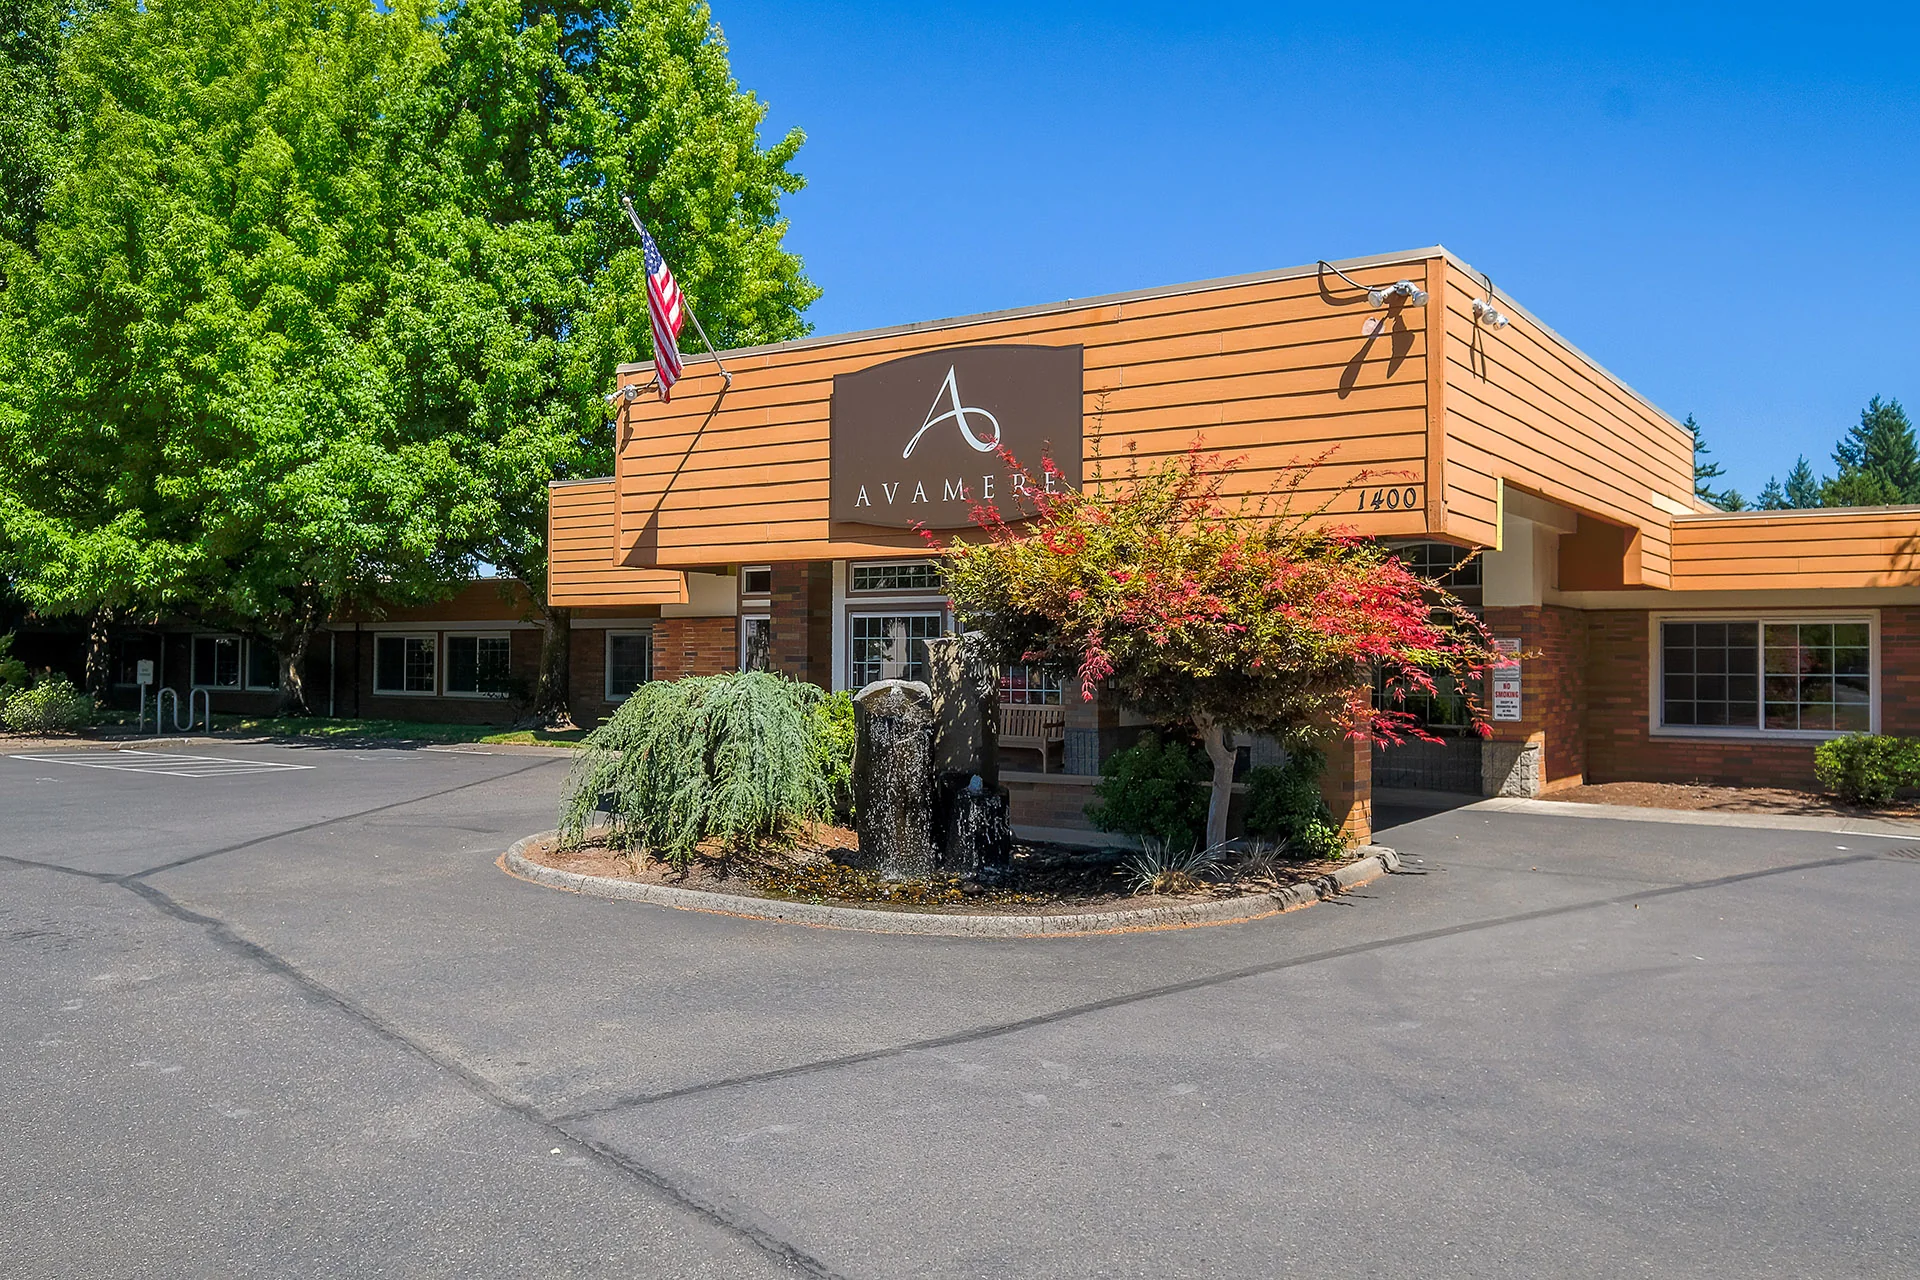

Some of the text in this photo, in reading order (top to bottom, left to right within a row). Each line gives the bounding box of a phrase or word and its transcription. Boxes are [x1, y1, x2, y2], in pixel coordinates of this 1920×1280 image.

[855, 471, 1060, 508] AVAMERE
[1358, 487, 1417, 511] 1400
[1503, 682, 1511, 690] NO
